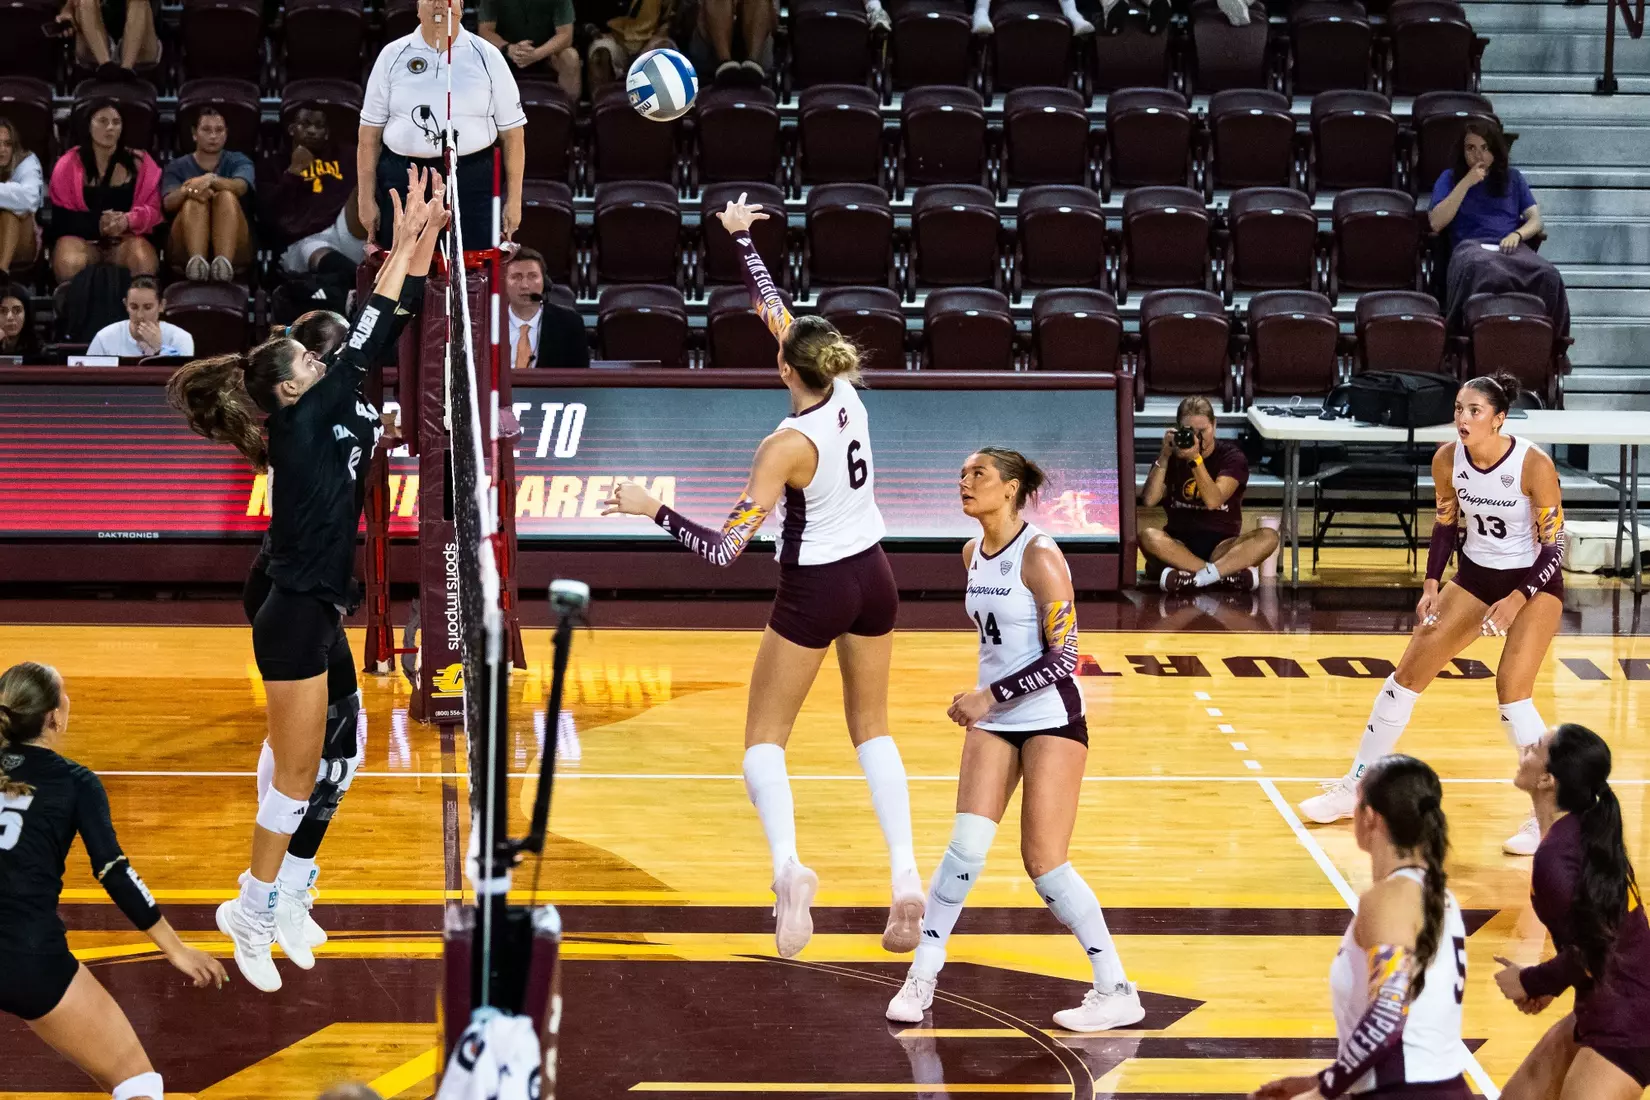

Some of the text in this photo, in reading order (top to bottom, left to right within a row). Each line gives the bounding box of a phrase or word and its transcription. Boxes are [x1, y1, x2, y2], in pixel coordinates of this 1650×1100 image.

[349, 304, 380, 350] GODEN
[535, 402, 588, 458] TO
[847, 439, 868, 490] 6
[1457, 488, 1518, 507] Chippewas
[678, 526, 745, 567] CHIPPEWAS
[1473, 514, 1508, 540] 13
[443, 543, 458, 590] sports
[966, 578, 1012, 598] hippewas
[445, 592, 461, 651] imports
[973, 610, 1003, 645] 14
[1018, 634, 1078, 694] CHIPPEWAS
